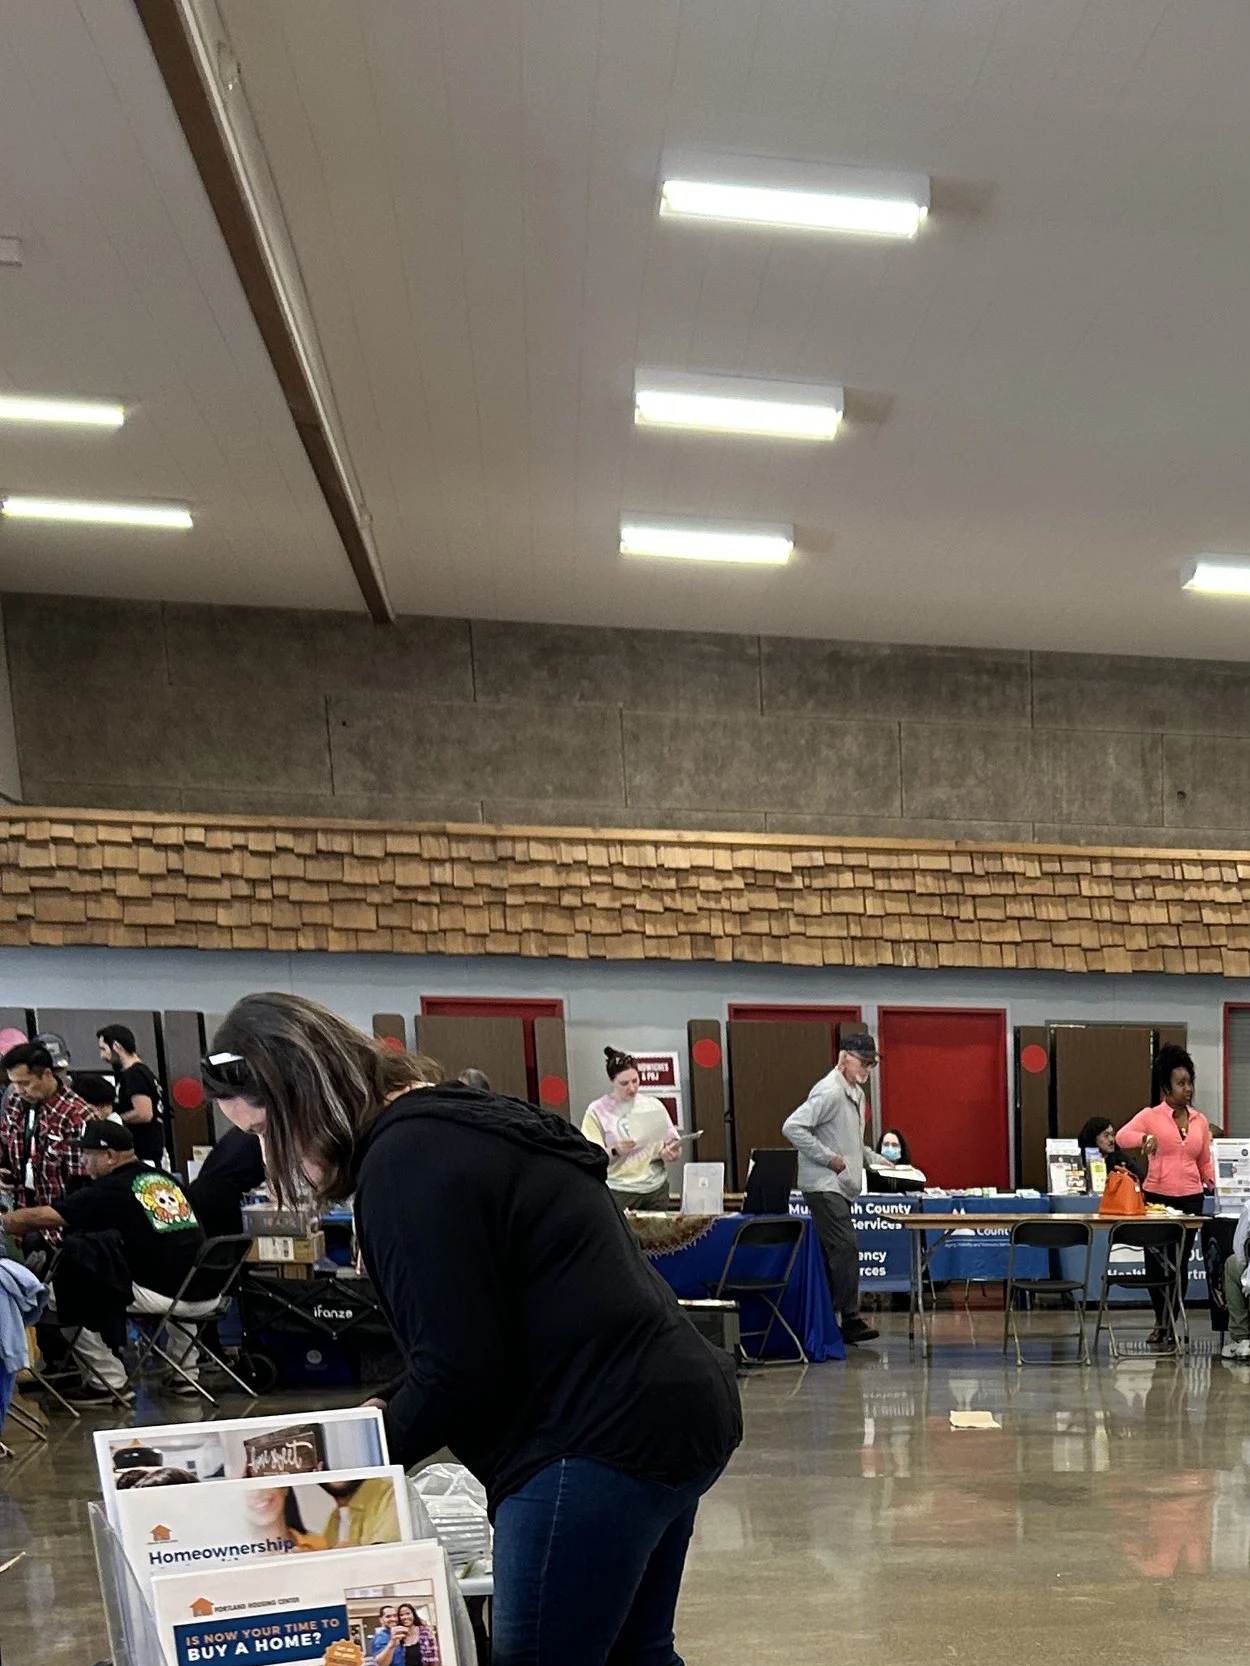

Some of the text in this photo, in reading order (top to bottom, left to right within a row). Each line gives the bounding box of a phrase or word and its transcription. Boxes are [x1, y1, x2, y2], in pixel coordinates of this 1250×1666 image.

[866, 1204, 911, 1215] County
[977, 1228, 1011, 1236] Count
[149, 1537, 295, 1565] Homeownership
[214, 1604, 246, 1613] PORTLAND
[248, 1600, 276, 1608] HOUSING
[186, 1618, 340, 1646] IS NOW YOUR TIME TO
[187, 1632, 322, 1661] BUY A HOME?
